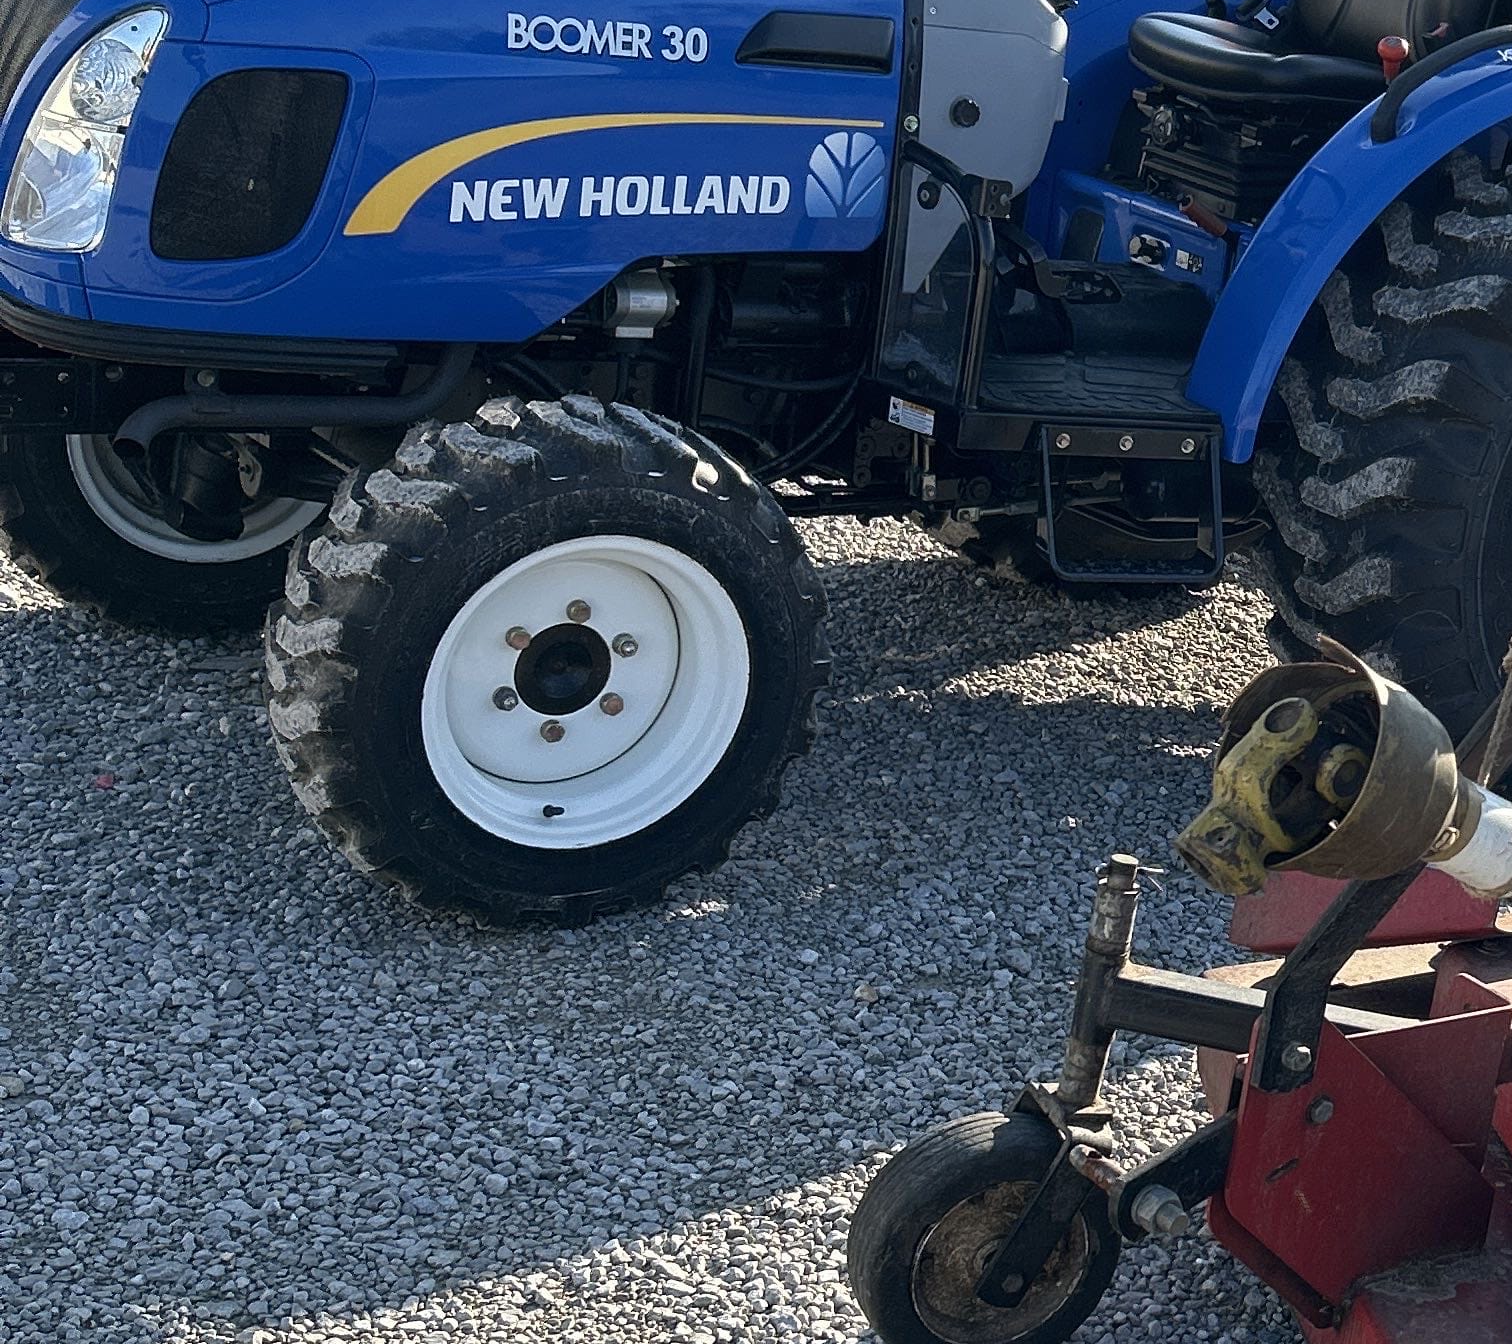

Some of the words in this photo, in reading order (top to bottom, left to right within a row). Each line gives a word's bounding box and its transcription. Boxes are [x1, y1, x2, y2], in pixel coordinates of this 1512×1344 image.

[507, 12, 653, 59] BOOMER
[661, 24, 708, 62] 30
[449, 177, 569, 223] NEW
[579, 175, 791, 217] HOLLAND
